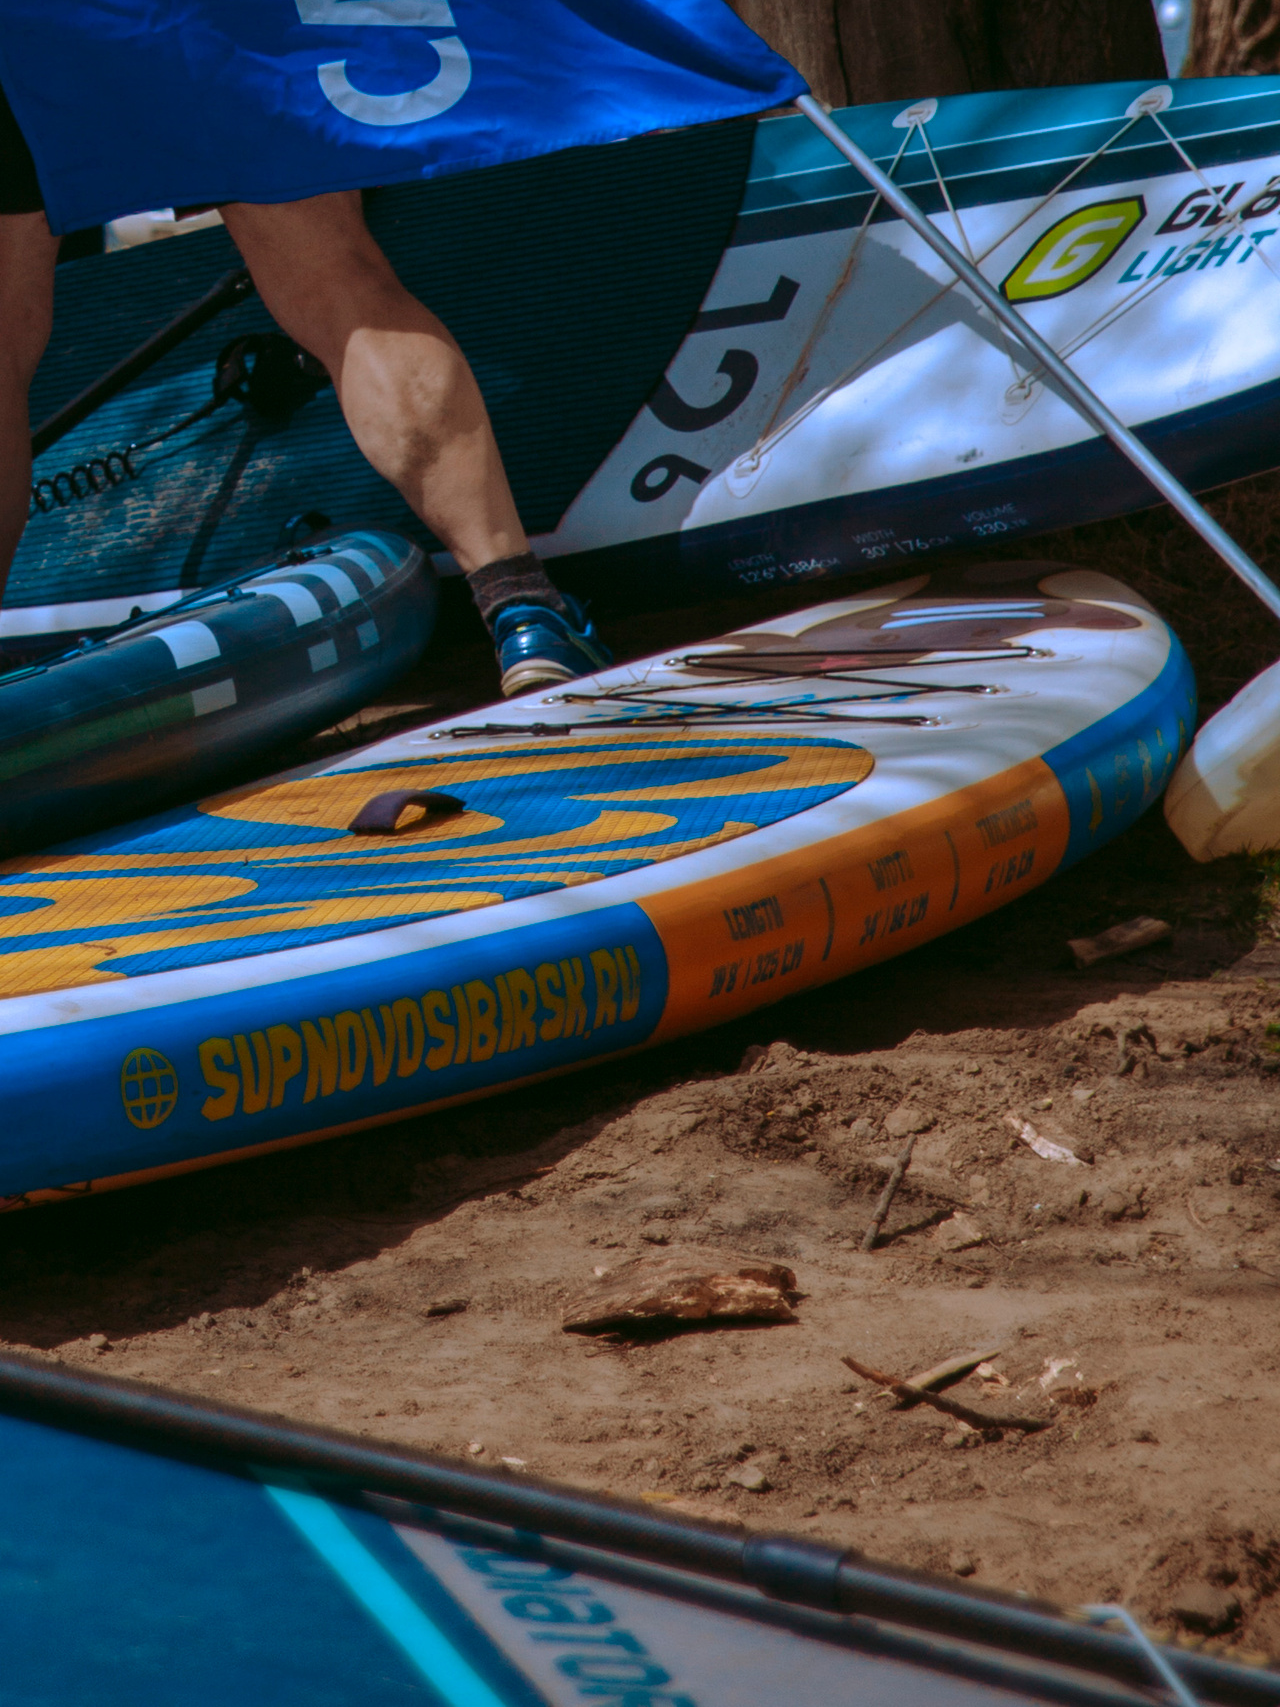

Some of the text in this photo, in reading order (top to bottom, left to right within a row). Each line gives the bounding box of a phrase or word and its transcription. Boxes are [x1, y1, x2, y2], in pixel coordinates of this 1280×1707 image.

[1118, 228, 1278, 284] LIGHT
[961, 502, 1019, 523] VOLUME
[851, 528, 896, 545] WIDTH
[726, 552, 776, 572] LENGTH
[723, 895, 784, 941] LENGTH
[198, 945, 642, 1122] SUPNOVOSIBIRSK.RU
